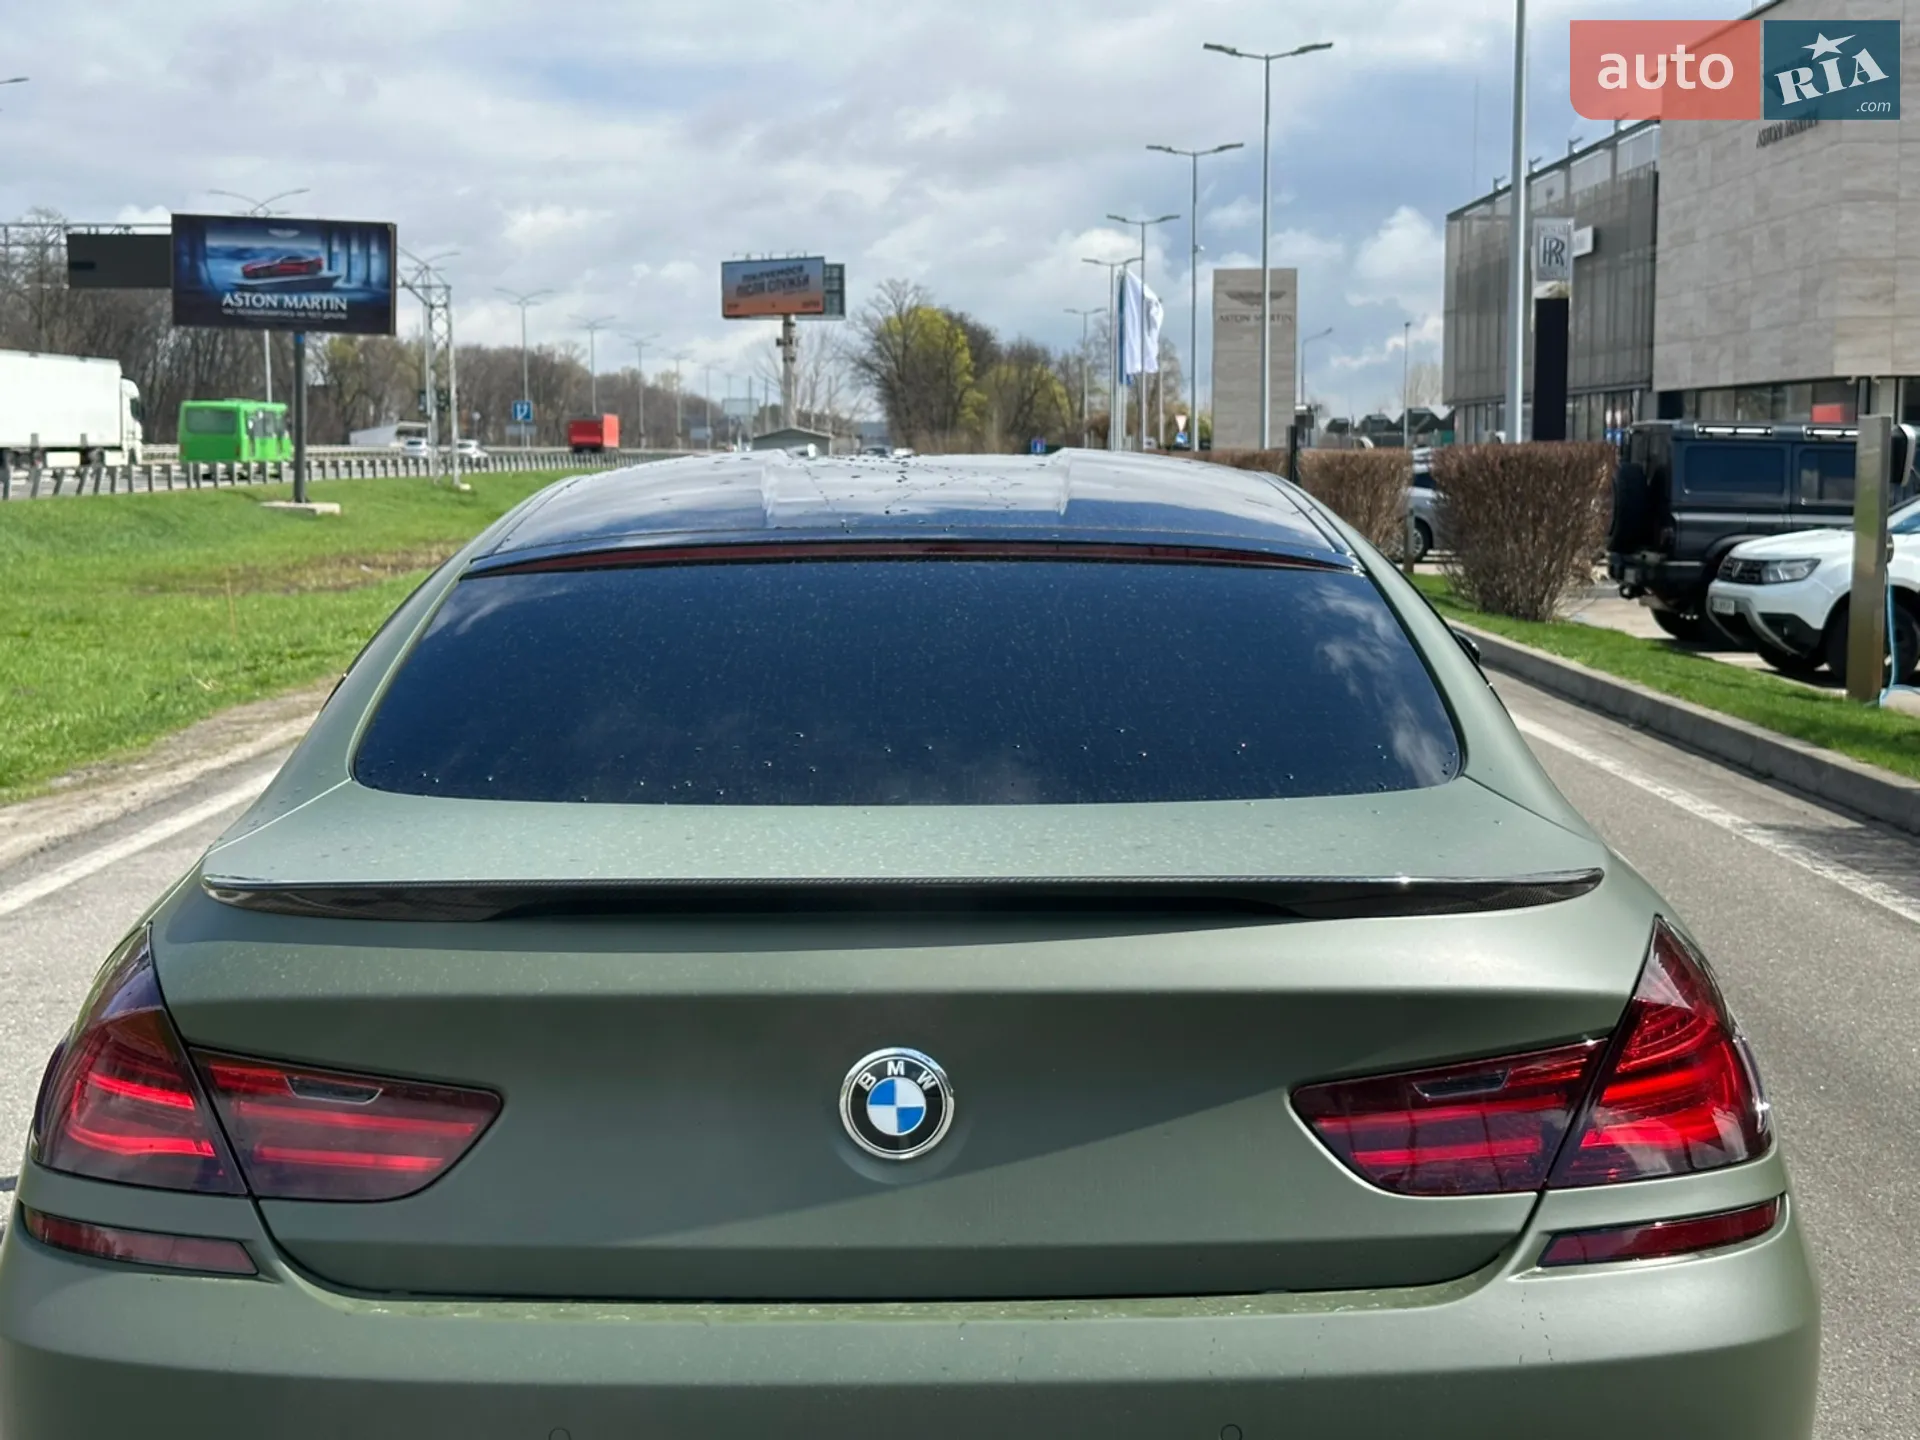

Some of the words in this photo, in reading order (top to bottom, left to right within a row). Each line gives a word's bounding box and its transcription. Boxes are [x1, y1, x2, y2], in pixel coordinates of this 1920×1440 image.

[222, 291, 278, 308] ASTON
[283, 294, 347, 311] MARTIN
[859, 1061, 936, 1090] BMW
